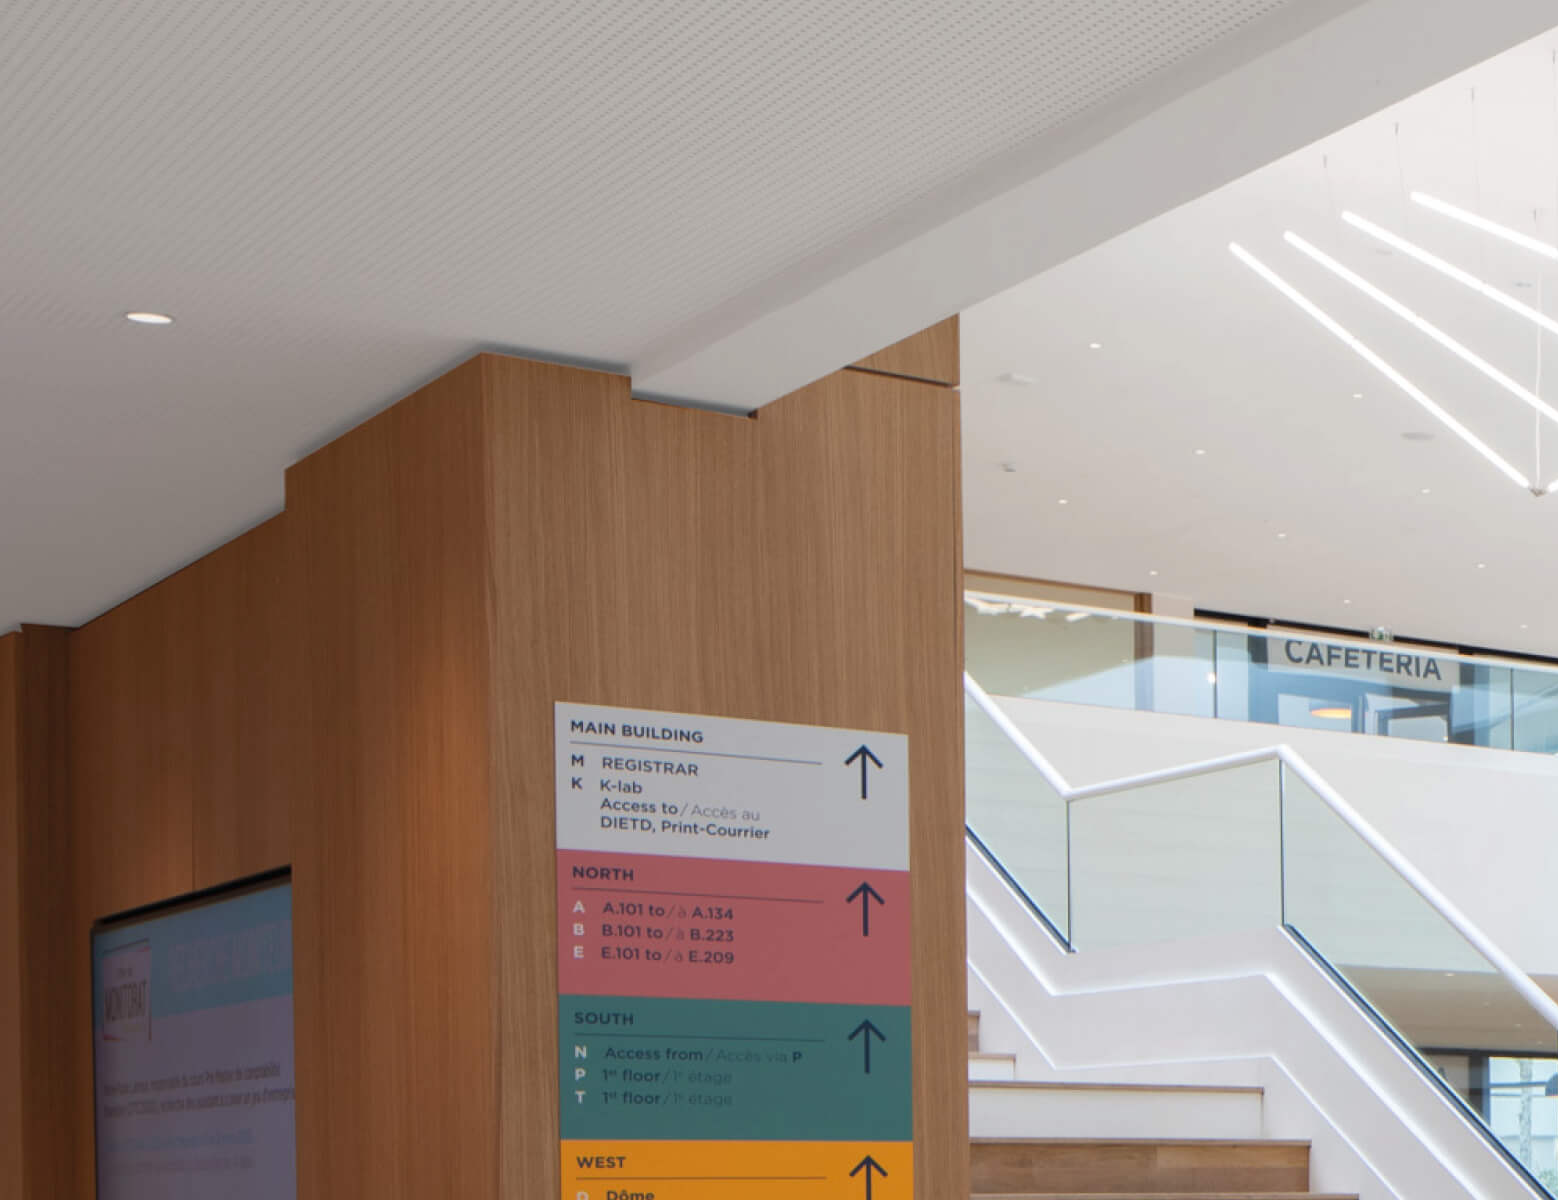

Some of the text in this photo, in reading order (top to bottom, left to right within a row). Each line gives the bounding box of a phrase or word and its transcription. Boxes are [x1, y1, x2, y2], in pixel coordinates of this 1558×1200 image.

[1284, 639, 1442, 681] CAFETERIA
[570, 719, 704, 744] MAIN BUILDING
[571, 754, 699, 777] M REGISTRAR
[571, 776, 643, 795] K K-lab
[600, 797, 656, 814] Access
[691, 804, 737, 820] Accès
[741, 810, 761, 822] au
[600, 815, 770, 840] DIETD, Print-Courrier
[572, 866, 634, 881] NORTH
[572, 900, 585, 913] A
[603, 901, 644, 916] A.101
[691, 906, 734, 920] A.134
[573, 922, 585, 936] B
[602, 923, 642, 938] B.101
[690, 928, 734, 942] B.223
[573, 945, 585, 960] E
[601, 946, 640, 960] E.101
[688, 950, 735, 964] E.209
[574, 1011, 635, 1026] SOUTH
[574, 1045, 587, 1059] N
[605, 1047, 661, 1061] Access
[666, 1047, 703, 1062] from
[792, 1051, 803, 1063] P
[575, 1068, 586, 1081] P
[622, 1068, 661, 1083] floor
[575, 1090, 586, 1104] T
[622, 1090, 661, 1105] floor
[576, 1156, 627, 1170] WEST
